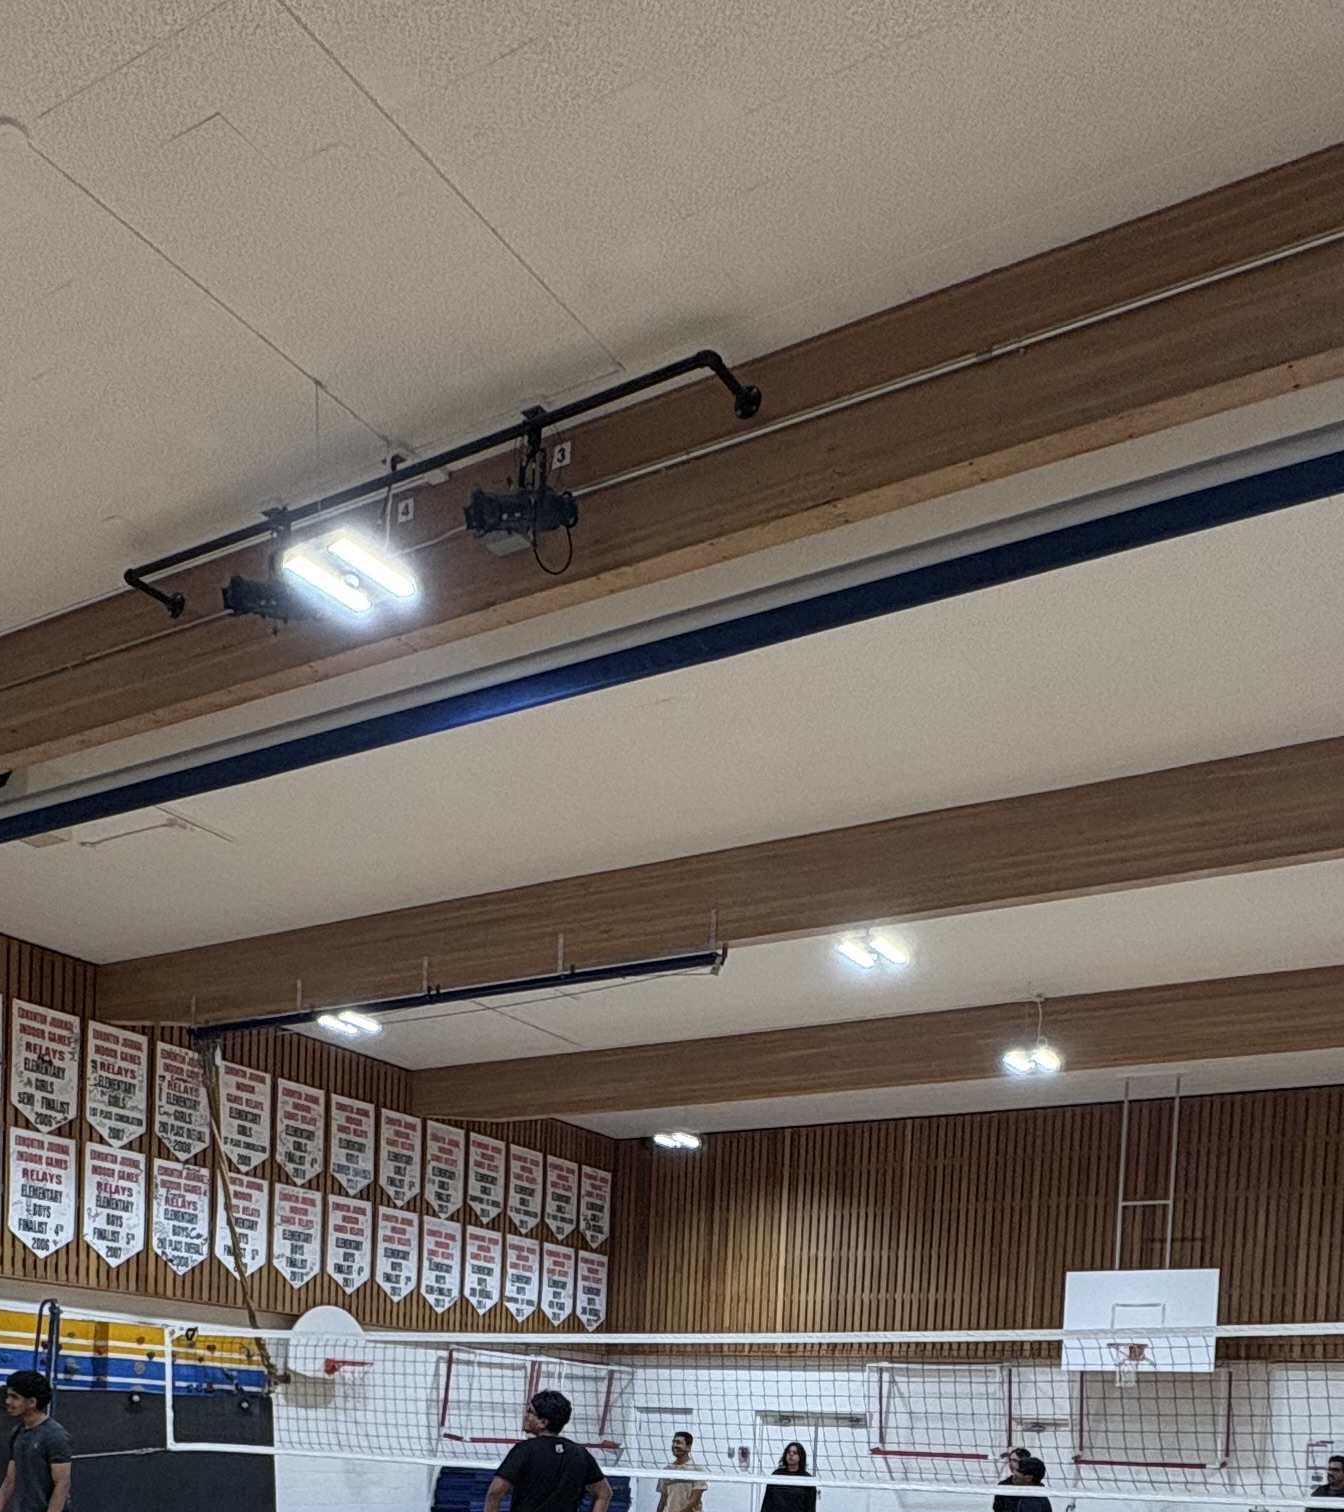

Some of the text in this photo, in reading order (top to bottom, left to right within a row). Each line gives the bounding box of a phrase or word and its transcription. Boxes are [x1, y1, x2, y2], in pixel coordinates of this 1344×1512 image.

[556, 447, 566, 463] 3
[401, 503, 410, 517] 4
[20, 1023, 72, 1047] INDOOR GAMES
[25, 1041, 65, 1061] RELAYS
[120, 1051, 141, 1065] GAMES
[24, 1057, 66, 1080] ELEMENTARY
[99, 1061, 136, 1080] RELAYS
[35, 1078, 54, 1094] GIRLS
[98, 1074, 136, 1096] ELEMENTARY
[167, 1080, 200, 1098] RELAYS
[18, 1092, 70, 1115] SEMI FINALIST
[108, 1094, 126, 1109] GIRLS
[166, 1092, 200, 1112] ELEMENTARY
[174, 1109, 192, 1125] GIRLS
[108, 1126, 125, 1141] 2007
[16, 1150, 68, 1170] INDOOR GAMES
[22, 1168, 63, 1185] RELAYS
[118, 1170, 139, 1183] GAMES
[21, 1184, 63, 1204] ELEMENTARY
[96, 1181, 133, 1197] RELAYS
[33, 1203, 51, 1218] BOYS
[96, 1195, 134, 1213] ELEMENTARY
[165, 1196, 198, 1211] RELAYS
[106, 1213, 123, 1228] BOYS
[164, 1208, 198, 1225] ELEMENTARY
[18, 1218, 48, 1234] FINALIST
[93, 1227, 120, 1243] FINALIST
[32, 1237, 50, 1251] 2006
[106, 1245, 122, 1259] 2007
